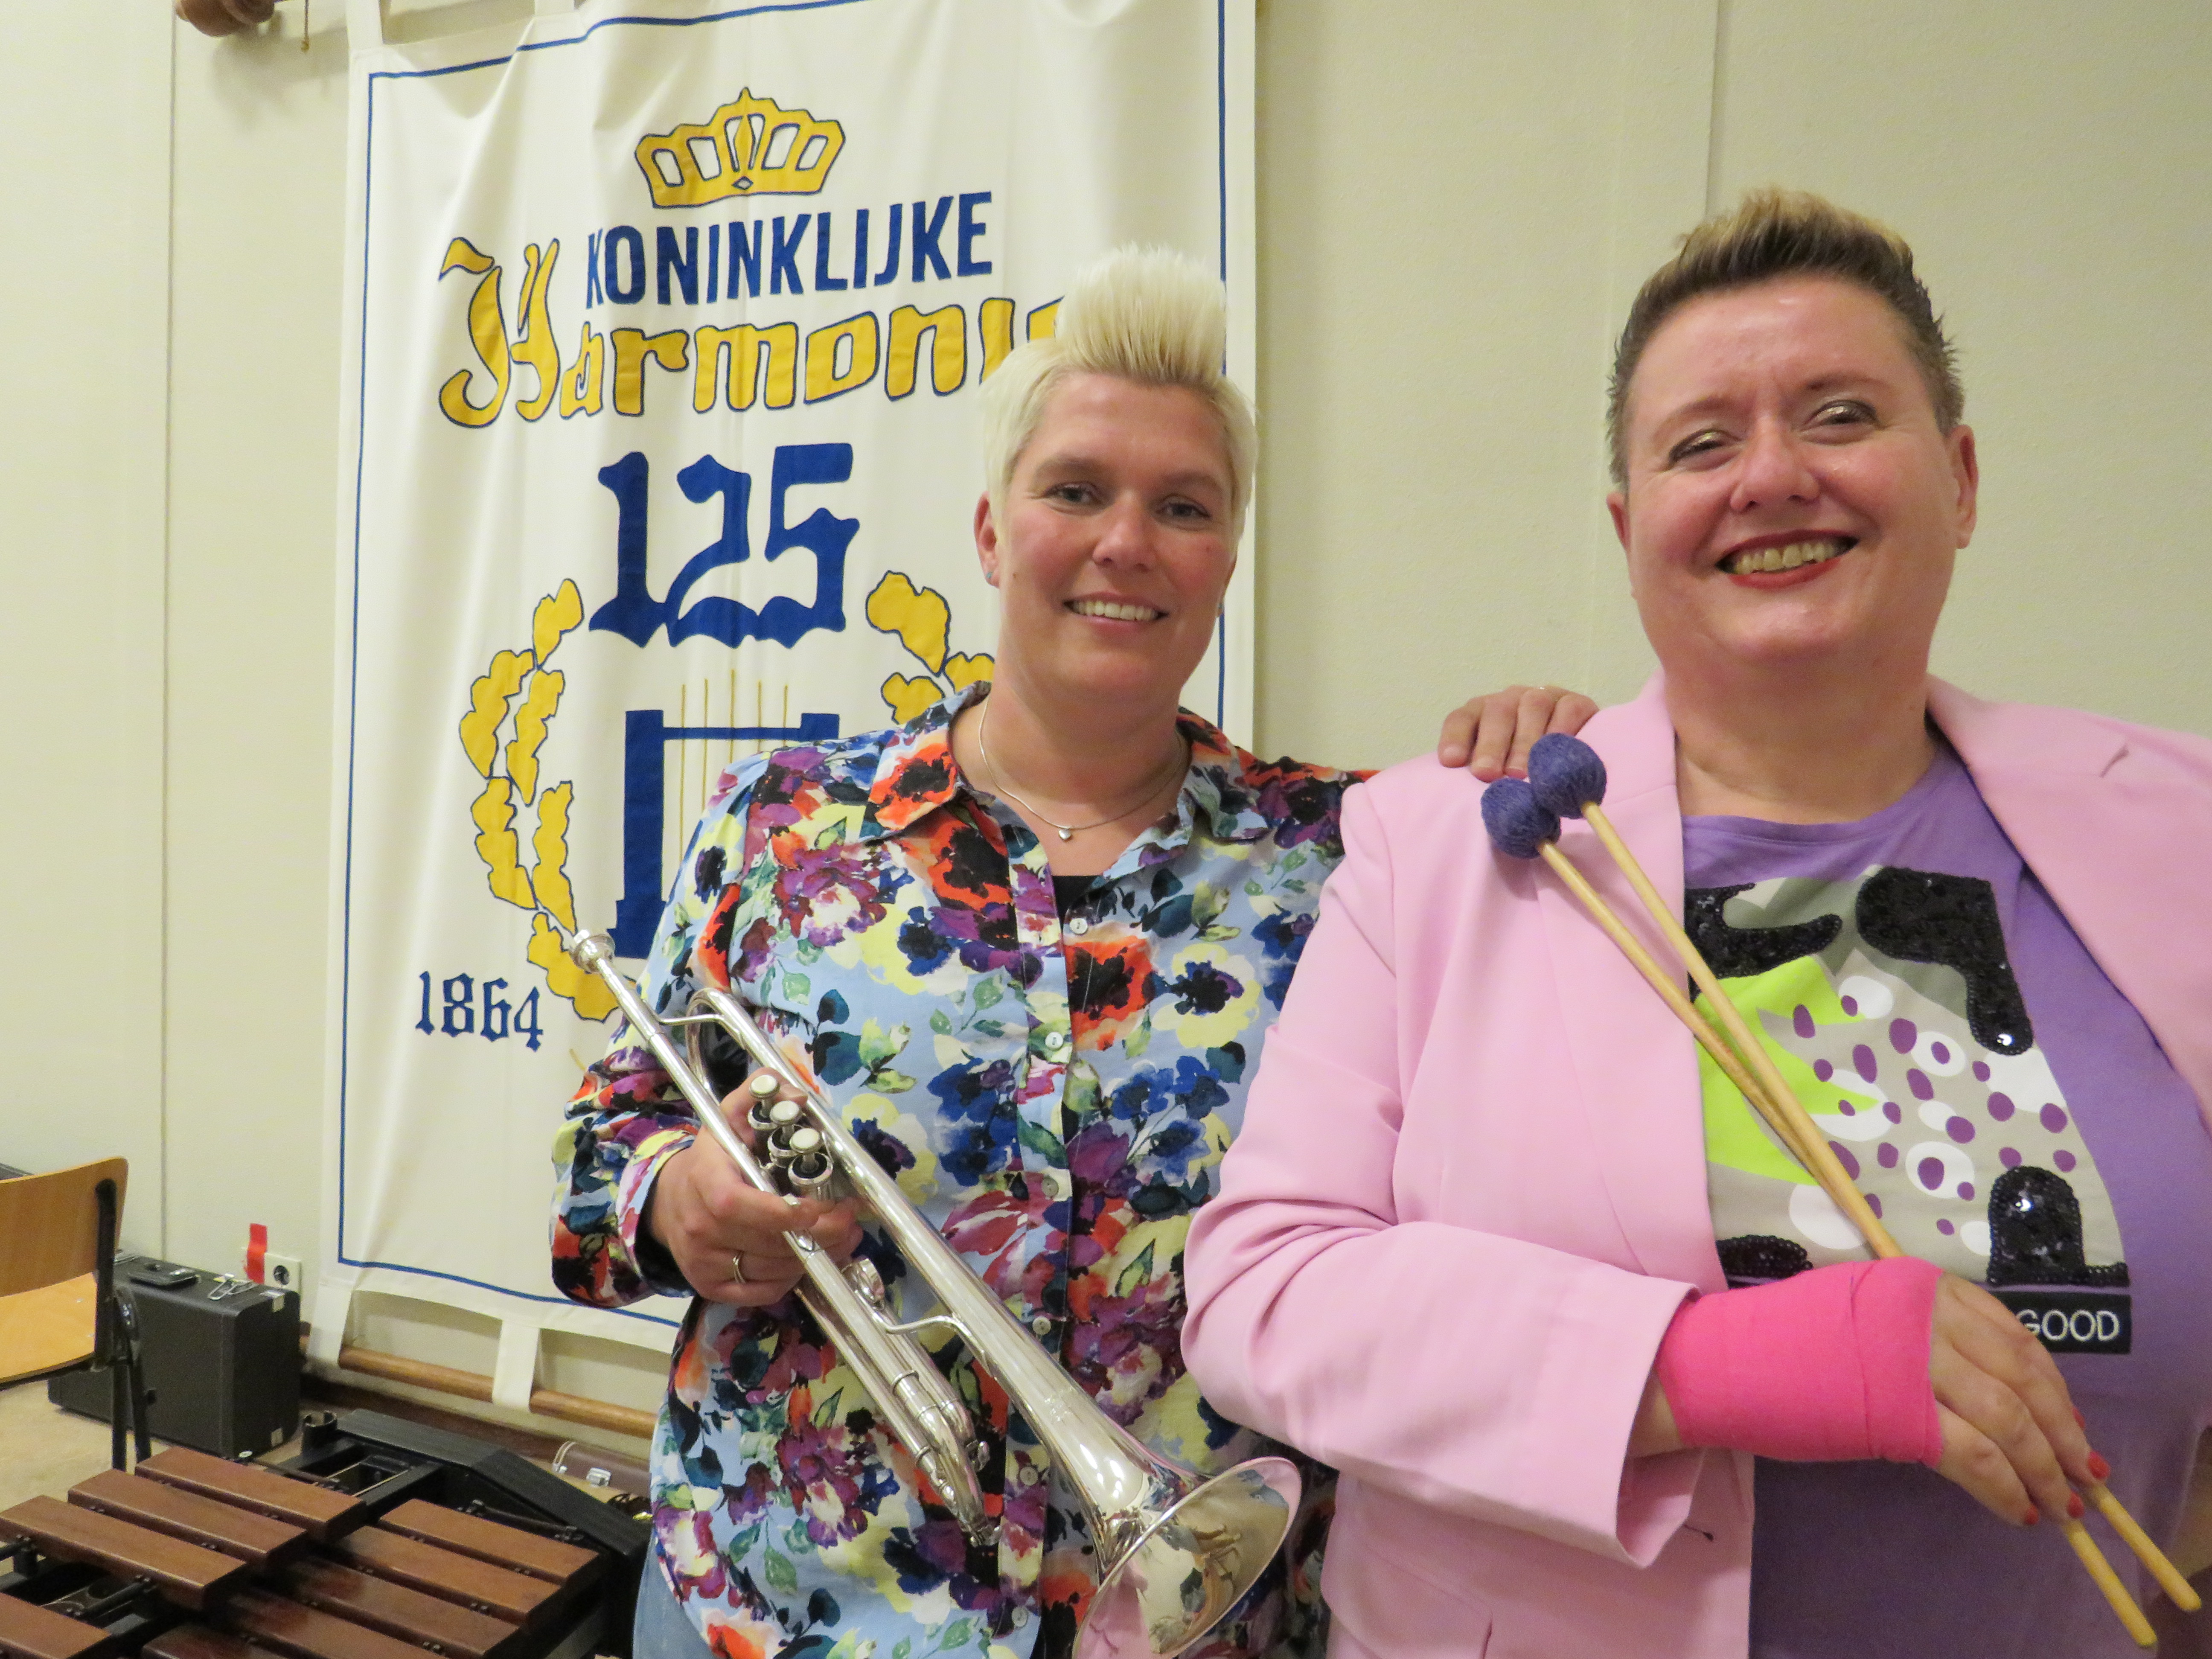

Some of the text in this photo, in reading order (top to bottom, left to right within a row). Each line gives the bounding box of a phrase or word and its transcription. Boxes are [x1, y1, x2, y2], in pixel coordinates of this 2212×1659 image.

[586, 191, 992, 309] KONINKLIJKE
[588, 442, 860, 649] 125
[415, 971, 544, 1052] 1864
[2014, 1308, 2120, 1342] GOOD
